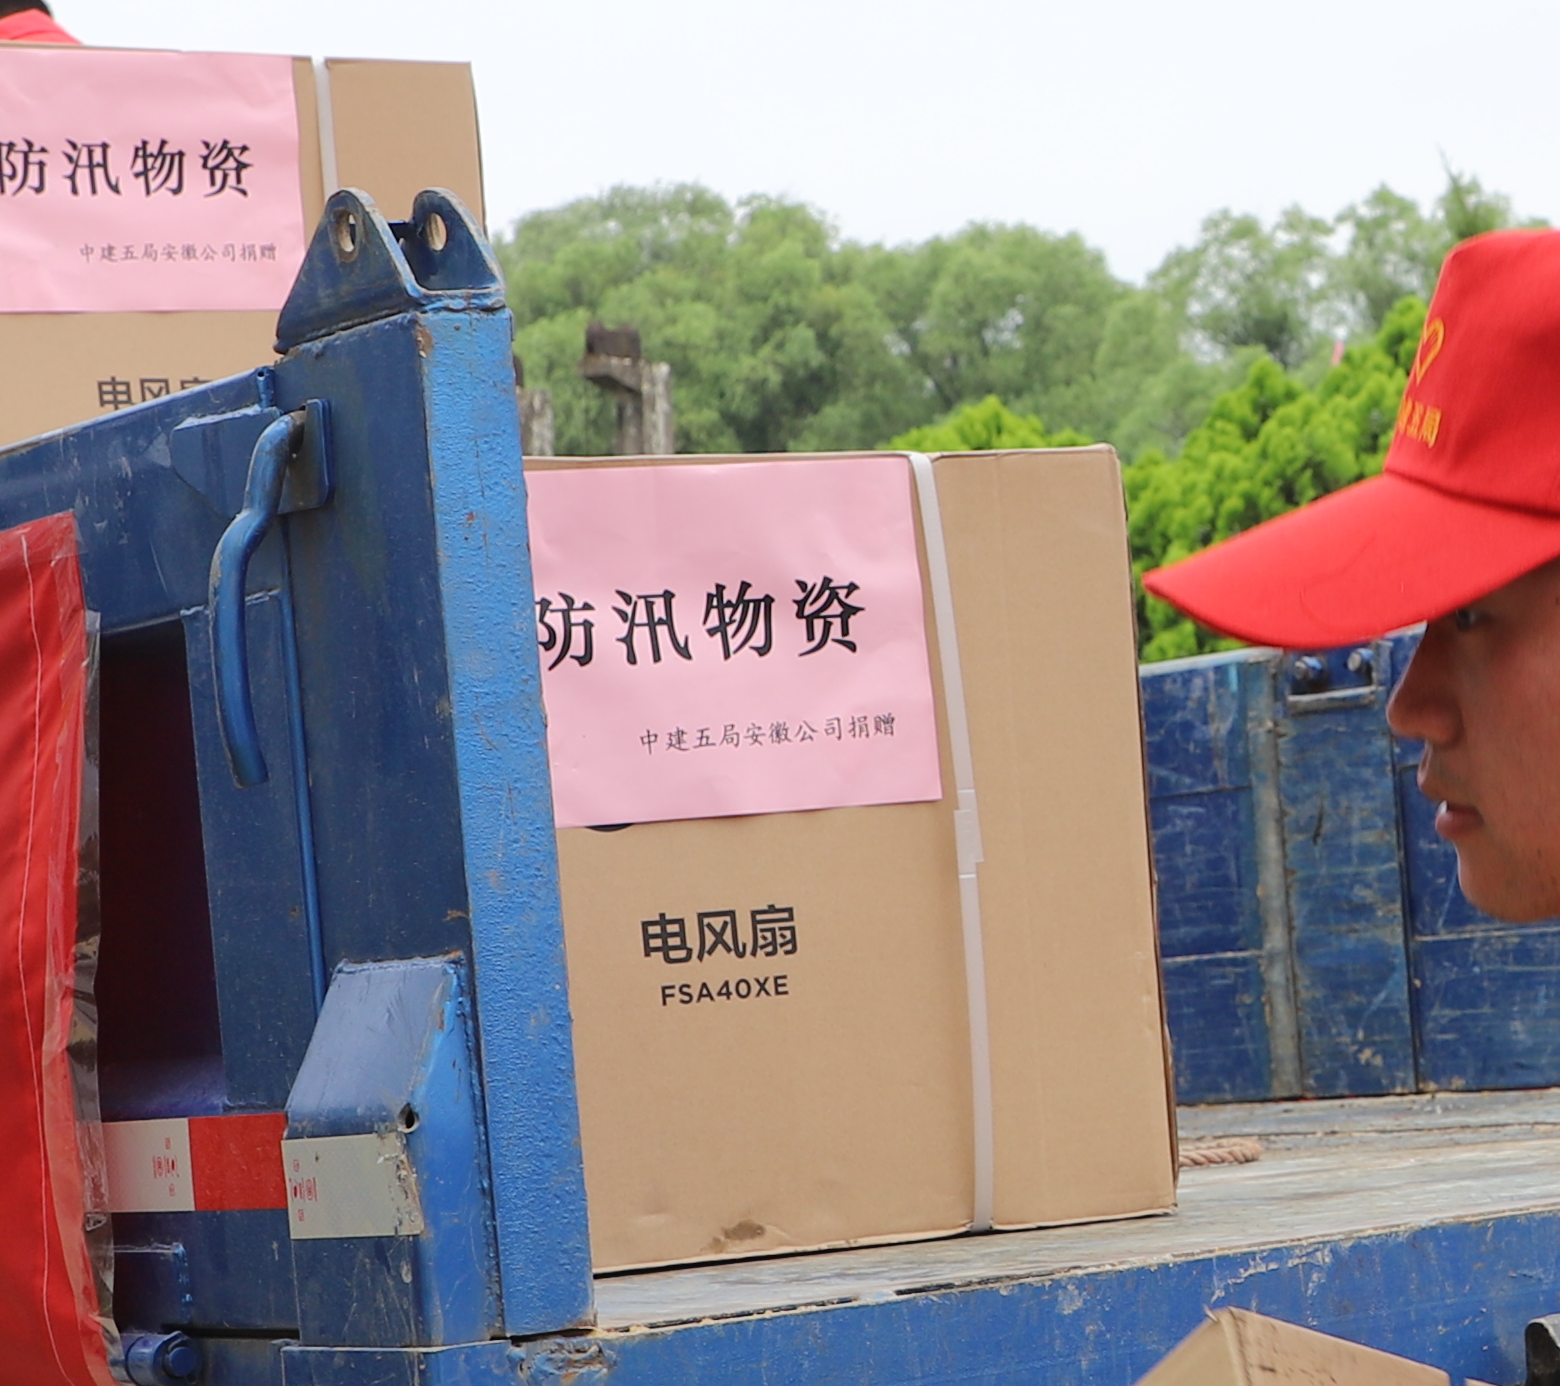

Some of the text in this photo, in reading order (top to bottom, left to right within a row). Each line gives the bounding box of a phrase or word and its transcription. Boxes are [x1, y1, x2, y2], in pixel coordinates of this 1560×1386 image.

[79, 242, 278, 263] 中建五局安徽公司捐赠
[534, 575, 866, 672] 防汛物资
[639, 712, 897, 756] 中建五局安徽公司捐赠
[640, 903, 799, 966] 电风扇
[659, 973, 791, 1008] FSA40XE
